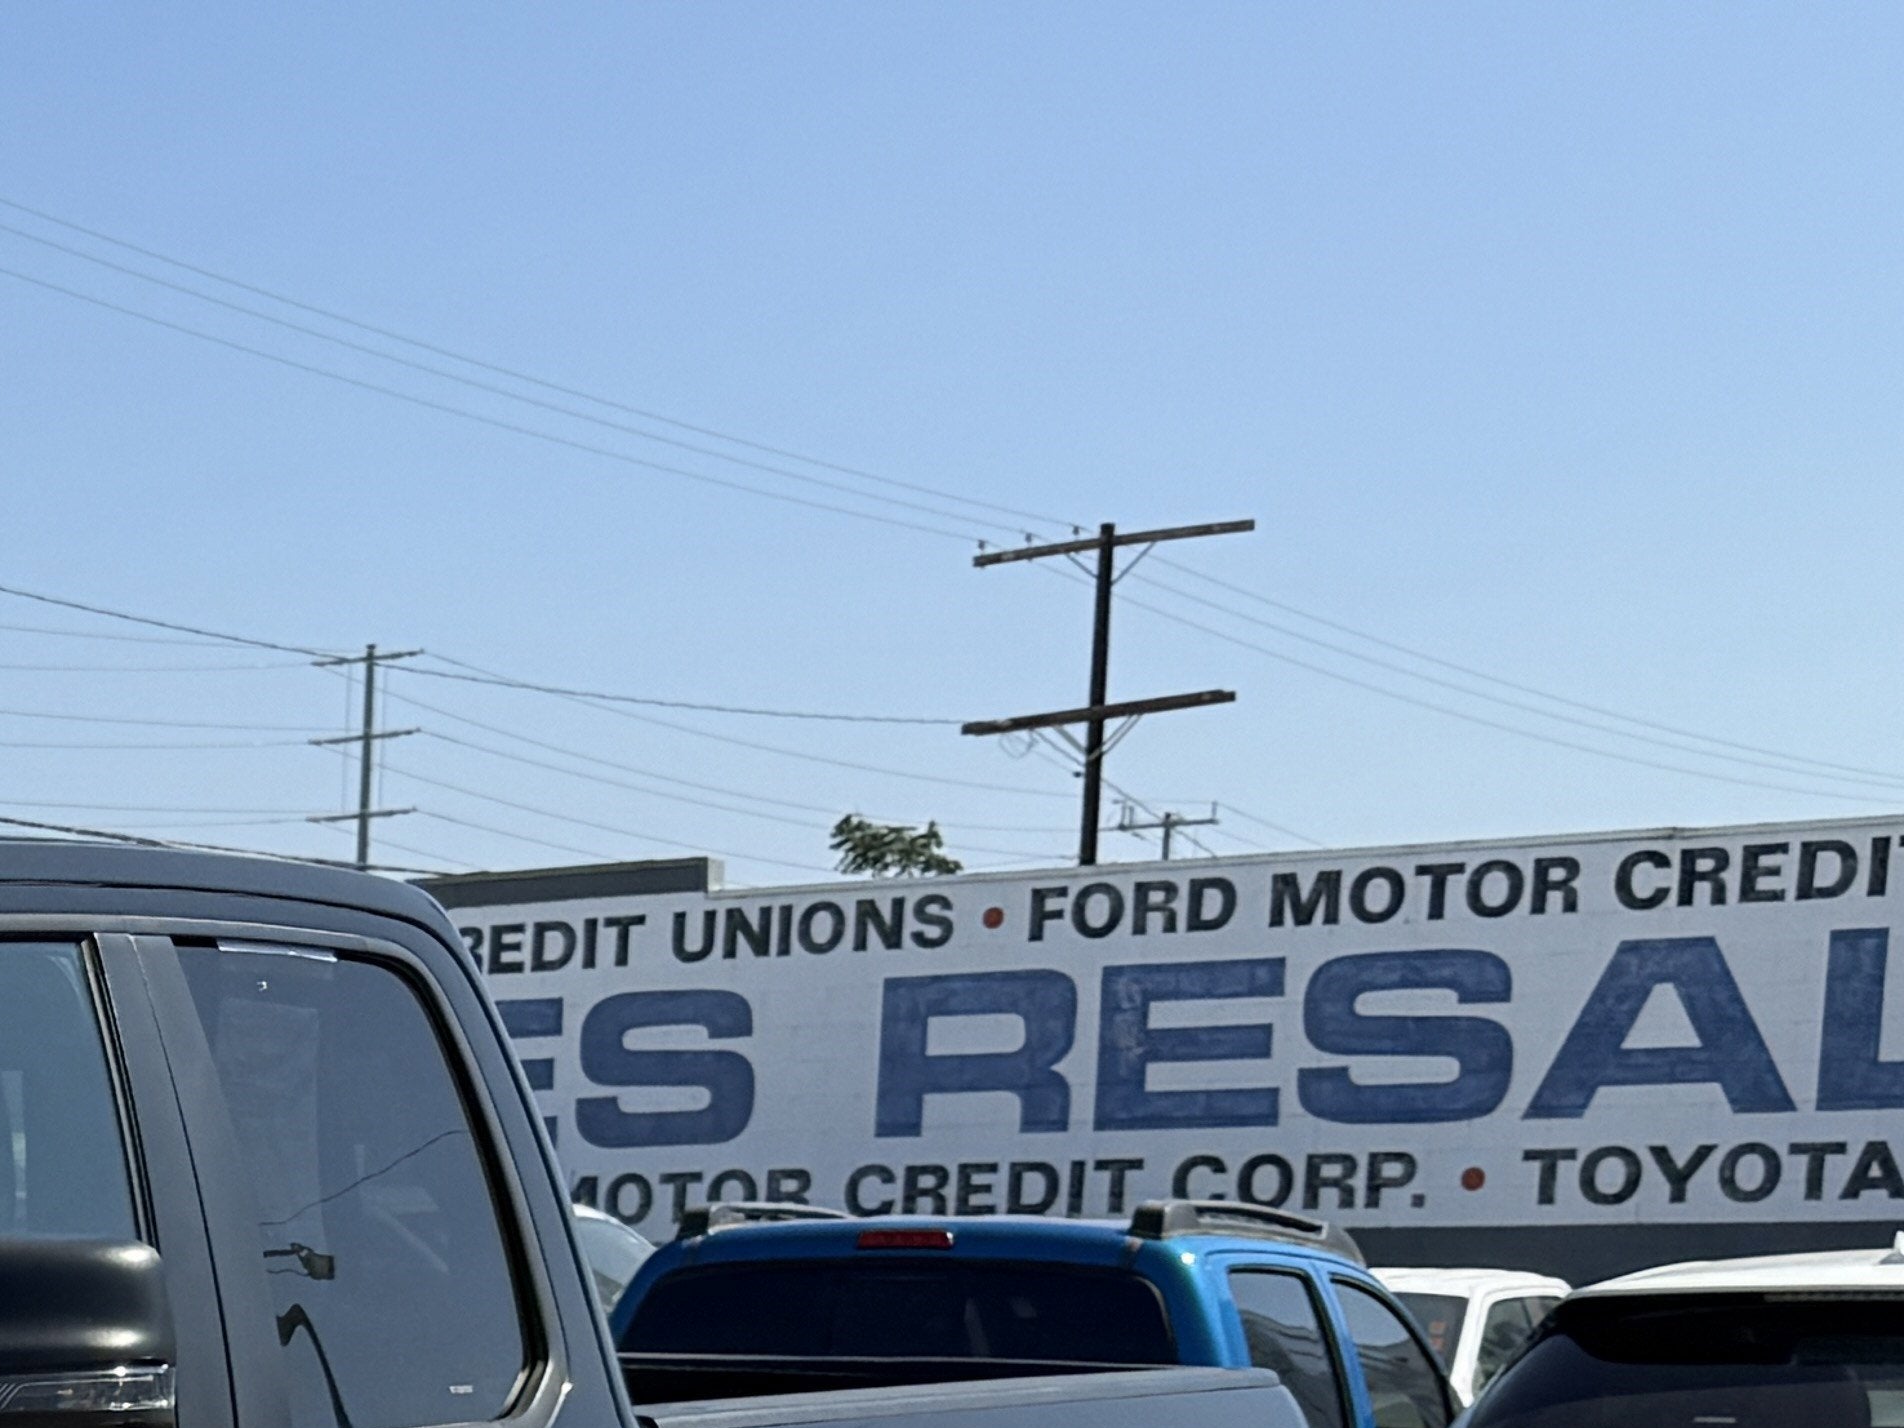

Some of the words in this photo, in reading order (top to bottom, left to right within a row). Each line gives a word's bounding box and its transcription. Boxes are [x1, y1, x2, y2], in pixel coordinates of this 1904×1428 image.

[672, 895, 955, 964] UNIONS
[1028, 875, 1238, 942] FORD
[1268, 856, 1581, 928] MOTOR
[1614, 835, 1904, 911] CREDI
[844, 1158, 1145, 1217] CREDIT
[1171, 1151, 1427, 1210] CORP.
[1521, 1140, 1904, 1206] TOYOTA
